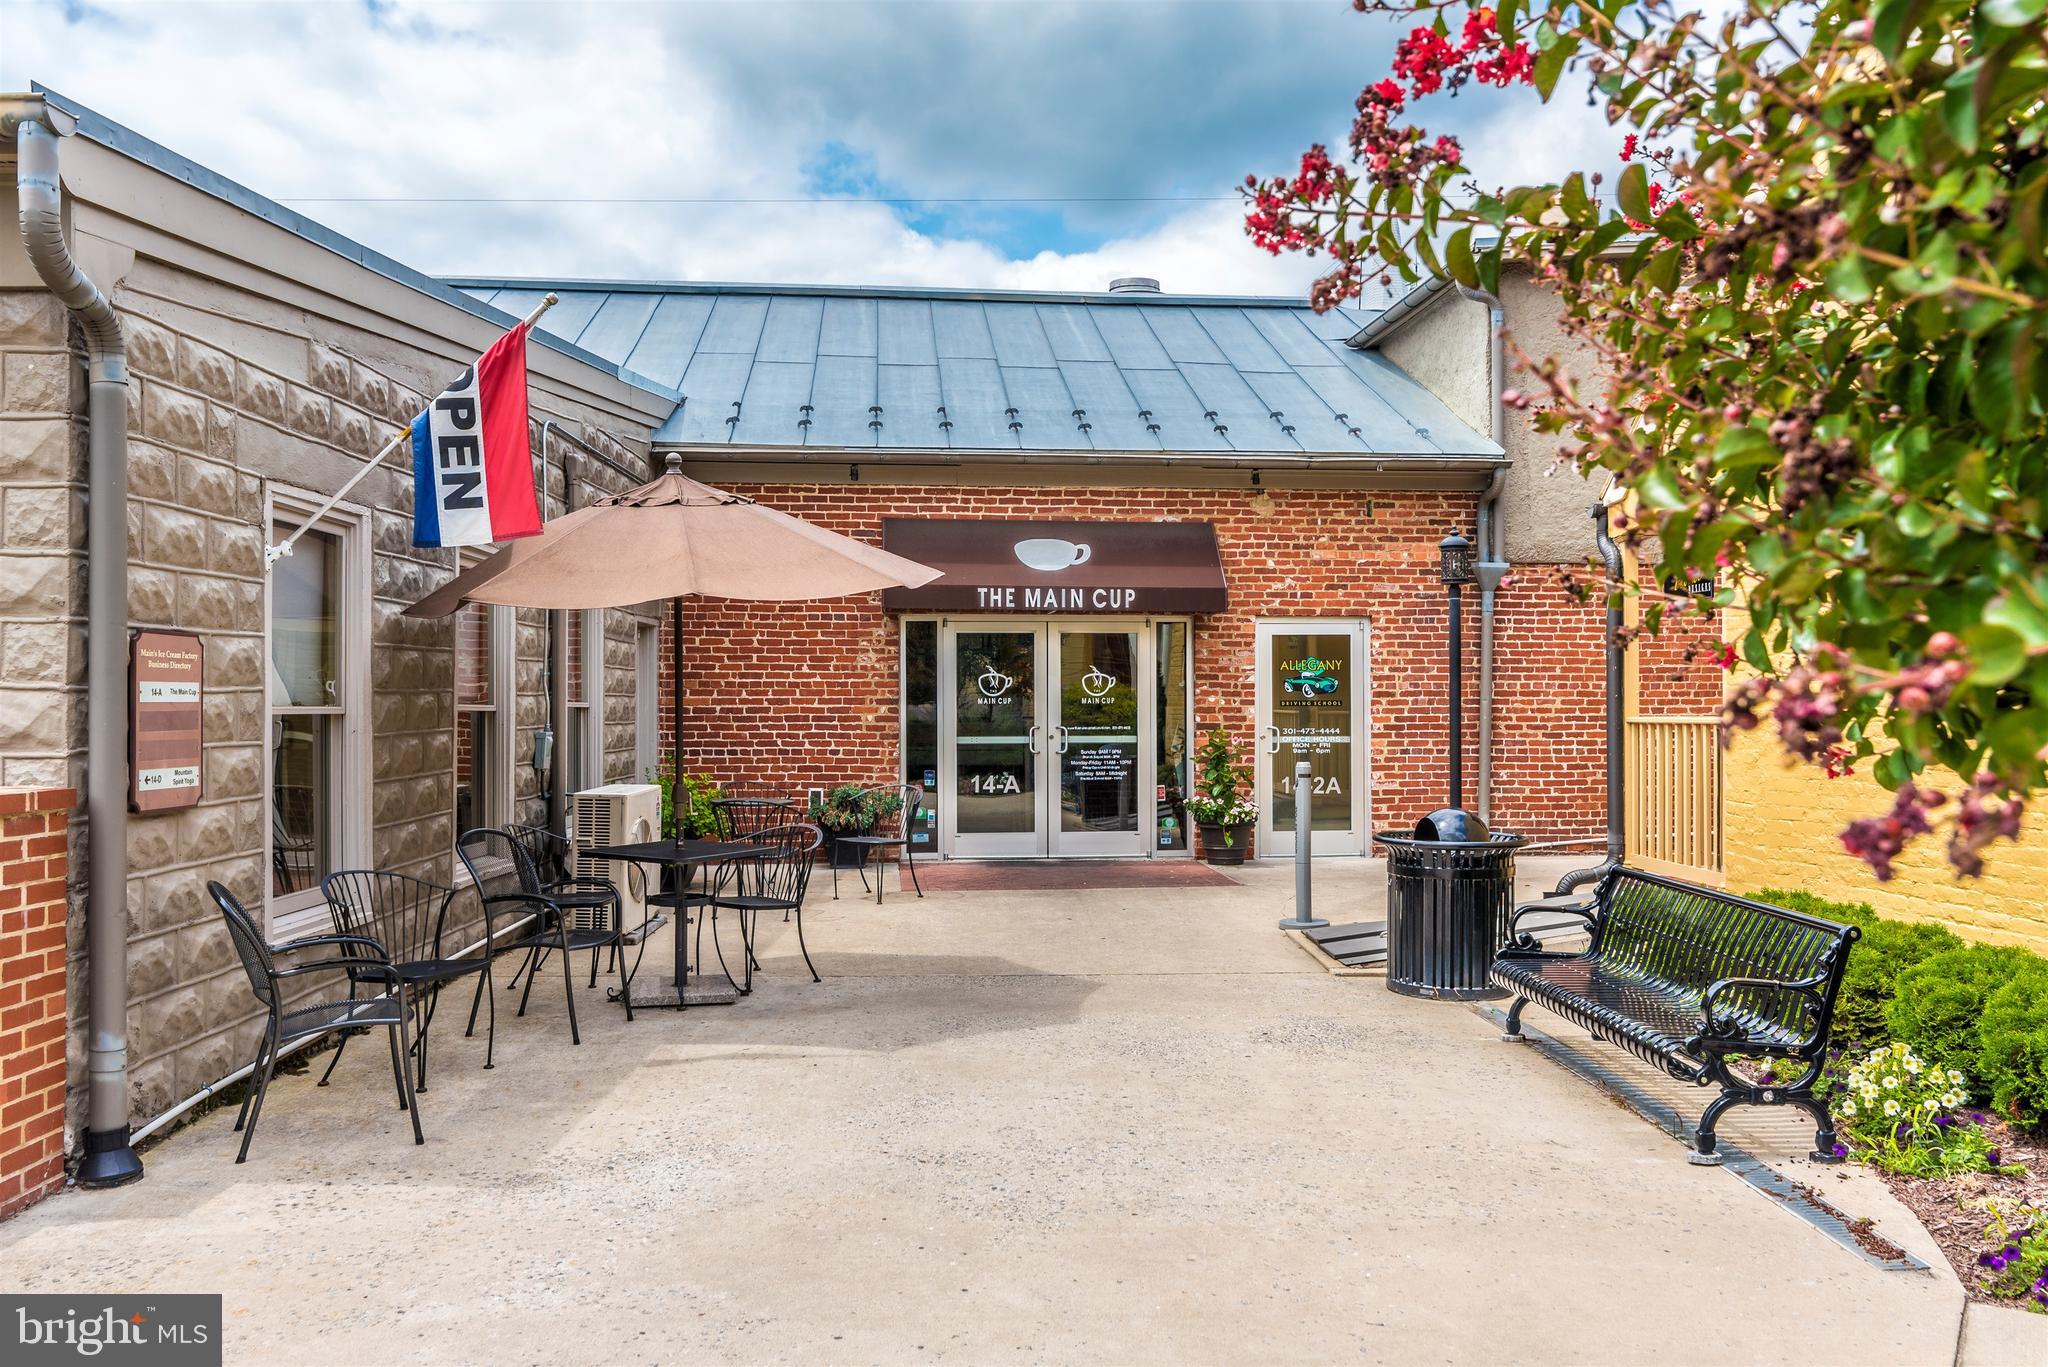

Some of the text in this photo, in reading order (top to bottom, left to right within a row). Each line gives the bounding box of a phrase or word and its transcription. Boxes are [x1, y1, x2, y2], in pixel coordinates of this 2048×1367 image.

[977, 587, 1136, 609] THE MAIN CUP
[158, 650, 166, 658] Ice
[166, 650, 181, 659] Cream
[182, 651, 199, 661] Factory
[148, 660, 191, 671] Business Directory
[1280, 659, 1342, 671] ALLEGANY
[151, 688, 163, 697] 14-A
[188, 688, 197, 696] Cup
[977, 697, 1012, 705] MAIN CUP
[151, 775, 162, 784] 14-D
[173, 778, 184, 786] Spirit
[971, 775, 1021, 793] 14-A
[1281, 776, 1341, 794] 12A
